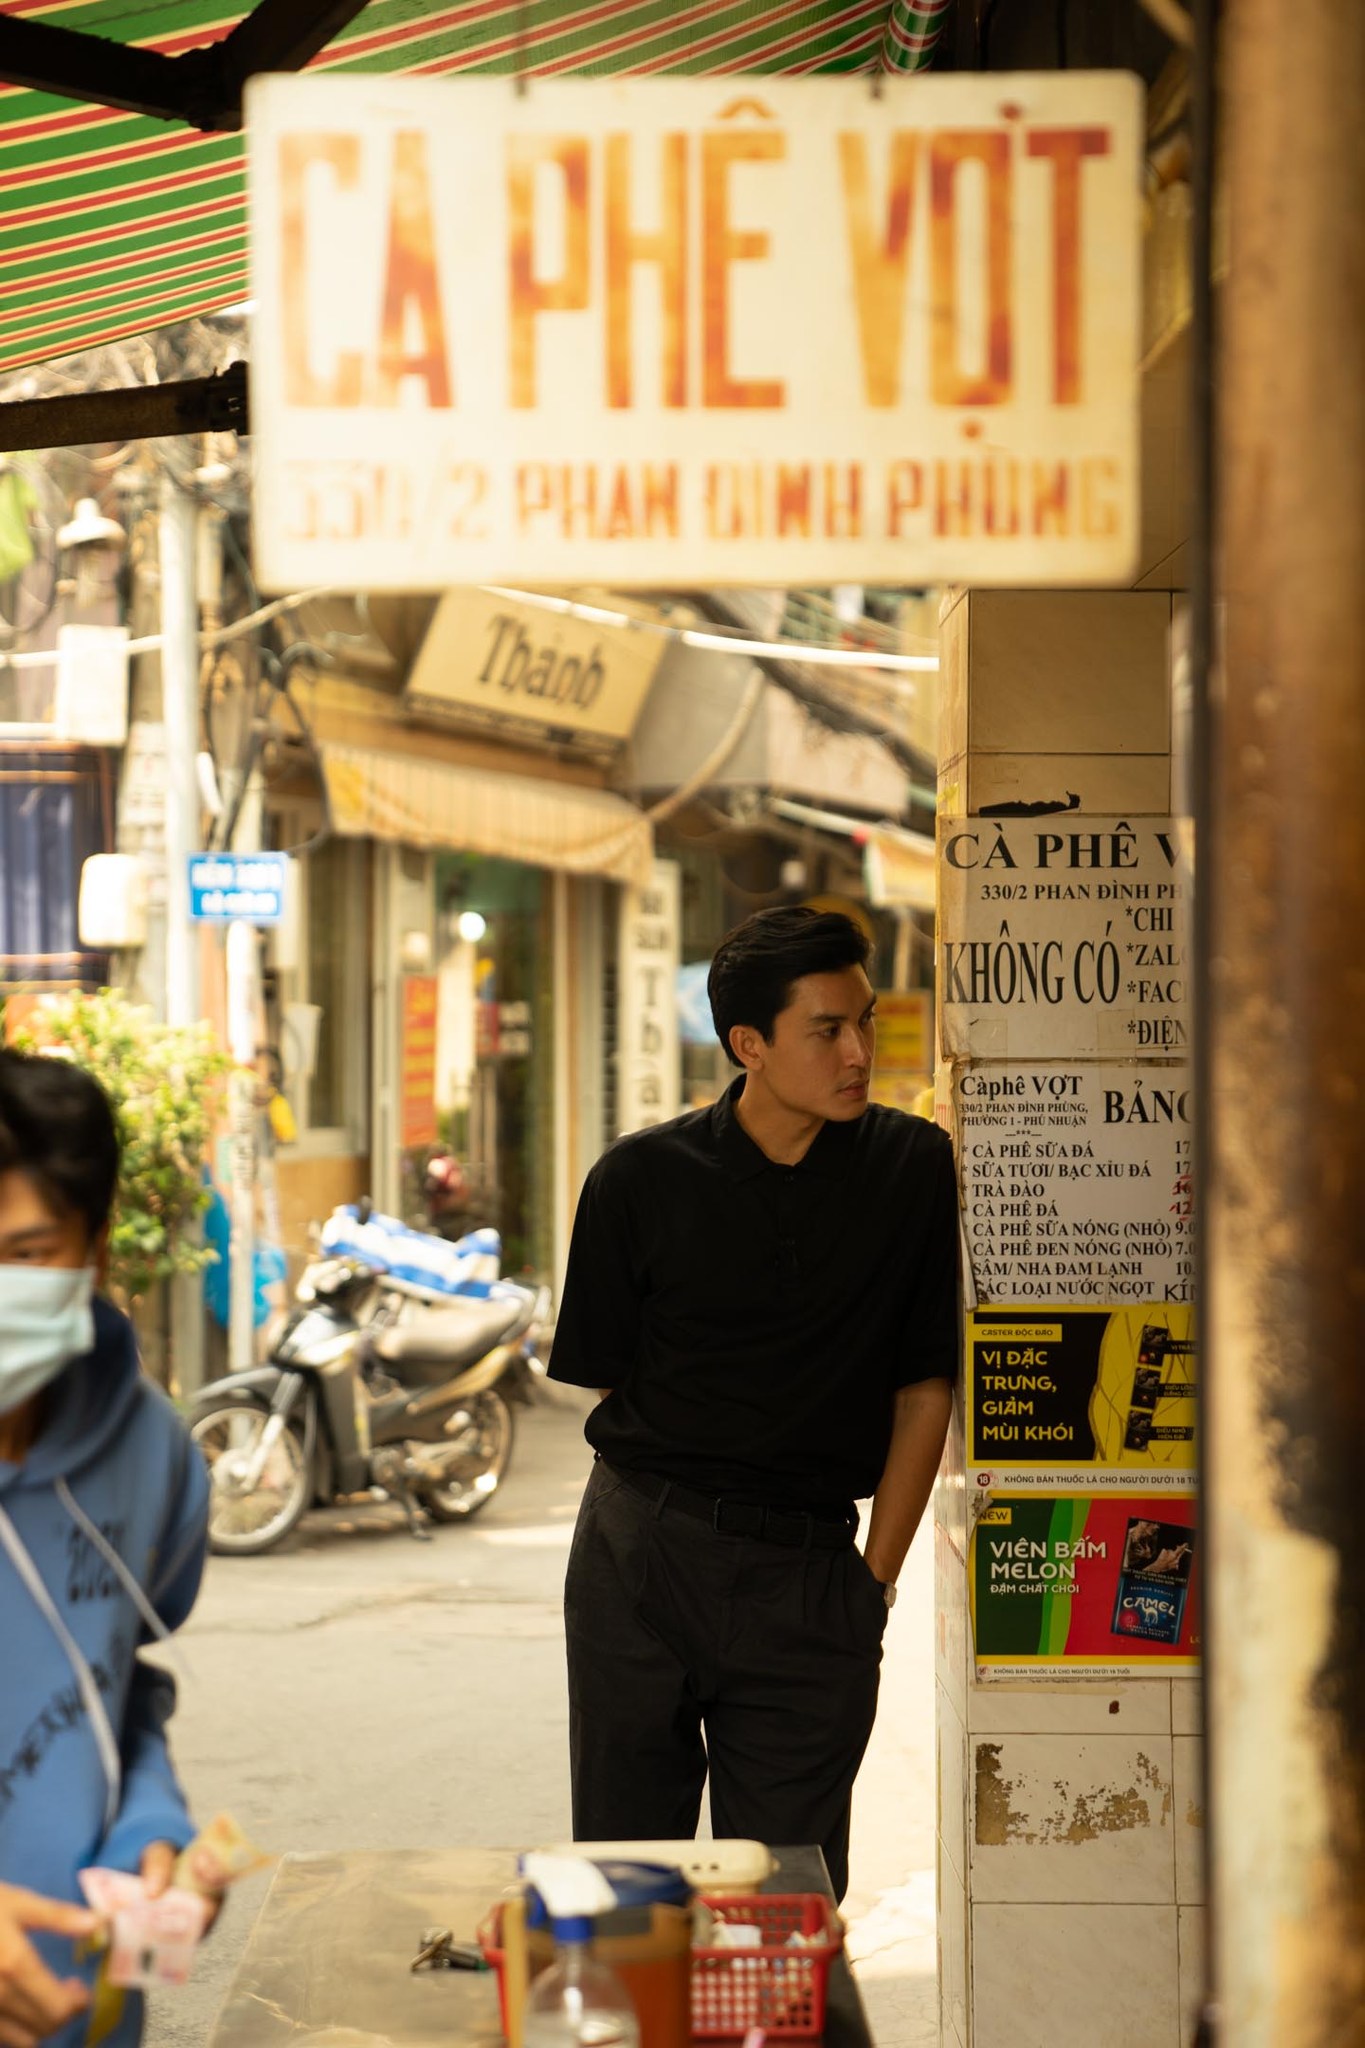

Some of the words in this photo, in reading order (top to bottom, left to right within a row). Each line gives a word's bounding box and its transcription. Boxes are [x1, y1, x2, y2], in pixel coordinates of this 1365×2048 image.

[506, 97, 787, 411] PHÊ
[837, 101, 1112, 440] VỢT
[513, 456, 683, 542] PHAN
[945, 823, 1019, 869] CÀ
[1034, 821, 1139, 869] PHÊ
[981, 884, 1028, 900] 330/2
[1034, 884, 1090, 899] PHAN
[1098, 881, 1149, 899] ĐÌNH
[943, 919, 1065, 1005] KHÔNG
[1073, 920, 1121, 1004] CÓ
[960, 1075, 1025, 1101] Càphê
[1031, 1074, 1083, 1100] VỢT
[960, 1103, 983, 1113] 330/2
[985, 1103, 1015, 1113] PHAN
[1017, 1101, 1045, 1113] ĐÌNH
[961, 1114, 1007, 1126] PHƯỜNG
[1010, 1116, 1015, 1126] 1
[1023, 1114, 1046, 1126] PHÚ
[1048, 1115, 1087, 1128] NHUẬN
[972, 1140, 995, 1158] CÀ
[1000, 1140, 1031, 1158] PHÊ
[1035, 1141, 1068, 1158] SỮA
[1072, 1140, 1095, 1158] ĐÁ
[972, 1161, 1005, 1178] SỮA
[1059, 1164, 1091, 1181] BẠC
[1128, 1160, 1152, 1177] ĐÁ
[972, 1180, 1005, 1197] TRÀ
[1009, 1180, 1045, 1197] ĐÀO
[972, 1200, 995, 1217] CÀ
[1000, 1200, 1032, 1217] PHÊ
[1036, 1200, 1058, 1217] ĐÁ
[973, 1219, 995, 1236] CÀ
[1000, 1219, 1032, 1236] PHÊ
[1036, 1220, 1068, 1236] SỮA
[1072, 1219, 1119, 1236] NÓNG
[1124, 1219, 1171, 1238] (NHỎ)
[973, 1239, 995, 1256] CÀ
[1000, 1239, 1032, 1256] PHÊ
[1036, 1242, 1069, 1256] ĐEN
[1074, 1239, 1120, 1256] NÓNG
[1125, 1239, 1172, 1258] (NHỎ)
[973, 1259, 1013, 1276] SÂM/
[1017, 1262, 1051, 1276] NHA
[1055, 1262, 1092, 1276] ĐAM
[1097, 1262, 1142, 1278] LẠNH
[1012, 1282, 1051, 1298] LOẠI
[1056, 1278, 1103, 1295] NƯỚC
[1108, 1282, 1155, 1297] NGỌT
[981, 1350, 1001, 1369] VỊ
[1007, 1347, 1048, 1369] ĐẶC
[981, 1375, 1057, 1393] TRƯNG,
[982, 1396, 1034, 1415] GIẢM
[983, 1422, 1019, 1441] MÙI
[1025, 1422, 1074, 1441] KHÓI
[1004, 1474, 1034, 1483] KHÔNG
[1036, 1474, 1054, 1483] BÁN
[1056, 1474, 1084, 1483] THUỐC
[1086, 1474, 1097, 1483] LÁ
[1120, 1474, 1149, 1483] NGƯỜI
[1151, 1474, 1174, 1484] DƯỚI
[1177, 1476, 1185, 1484] 18
[979, 1511, 1008, 1520] NEW
[990, 1537, 1047, 1559] VIÊN
[1054, 1535, 1106, 1559] BẤM
[991, 1562, 1075, 1579] MELON
[990, 1582, 1016, 1595] ĐẬM
[1019, 1582, 1048, 1593] CHẤT
[1123, 1597, 1176, 1616] CAMEL
